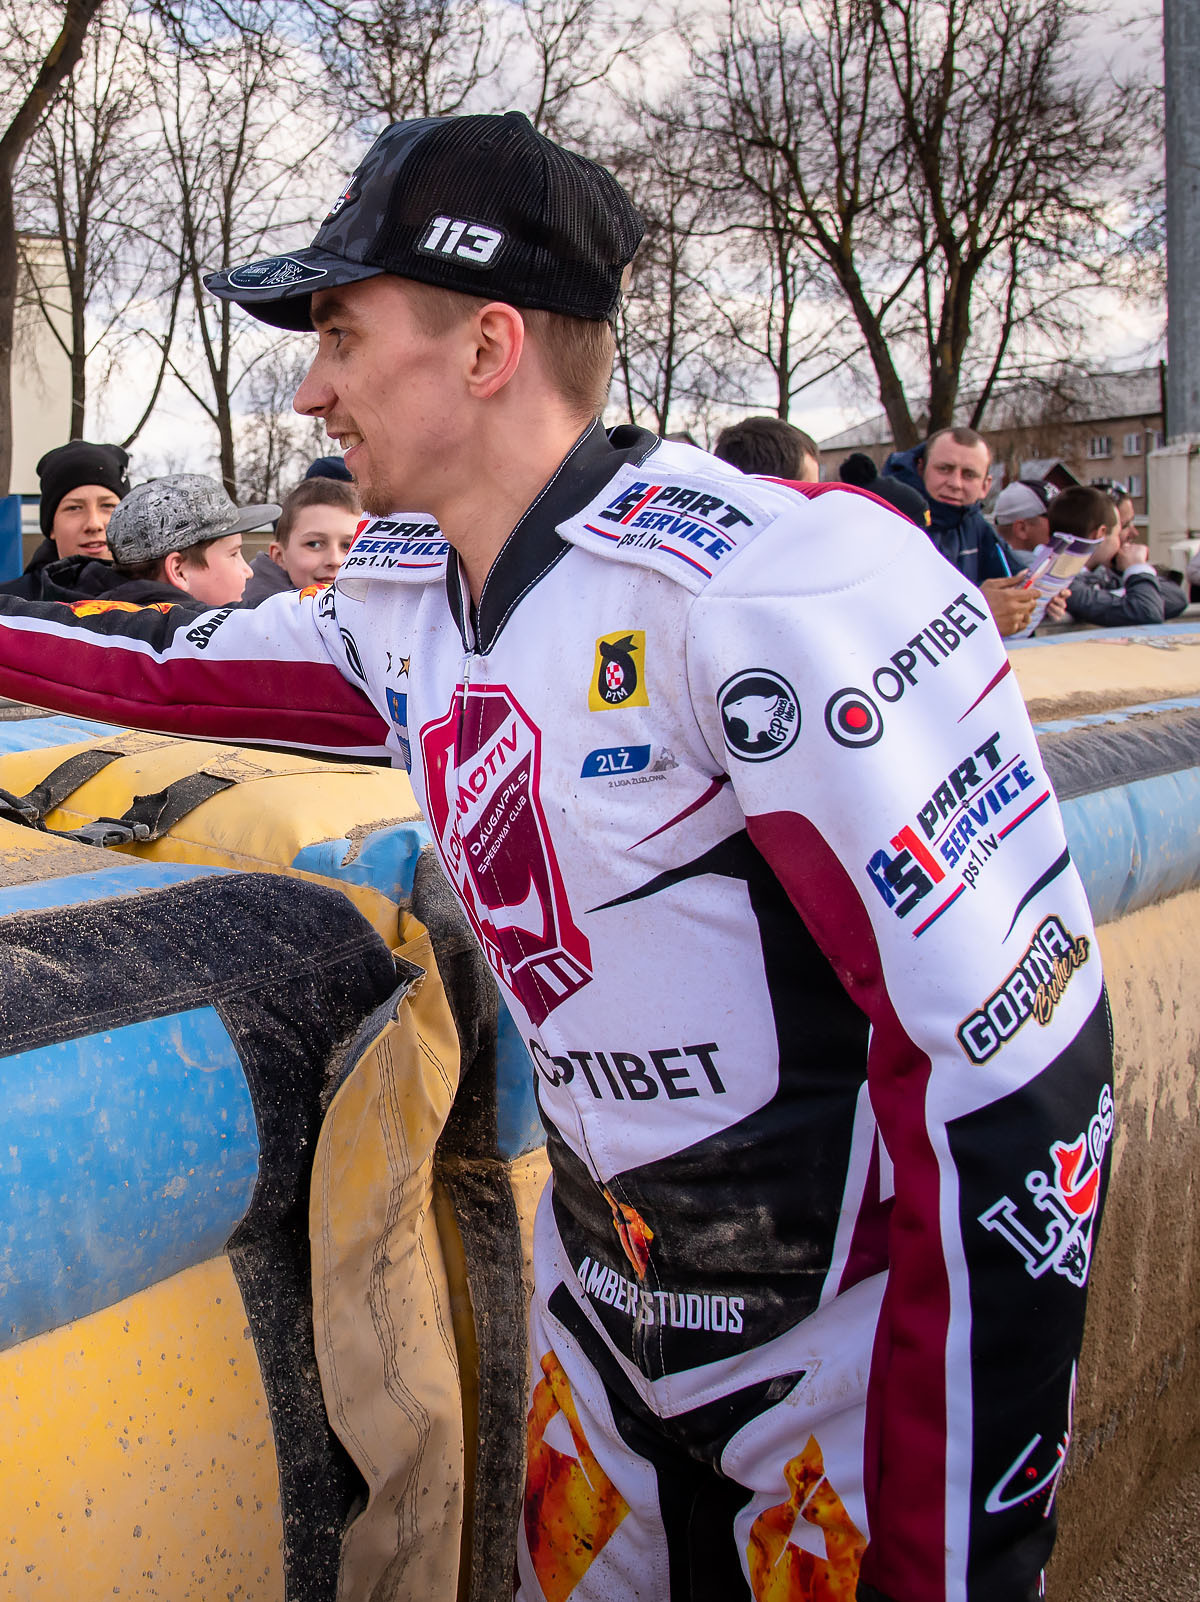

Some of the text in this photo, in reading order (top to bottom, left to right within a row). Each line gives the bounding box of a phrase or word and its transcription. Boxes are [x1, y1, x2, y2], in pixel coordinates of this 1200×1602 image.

[423, 215, 503, 263] 113
[365, 520, 444, 538] PAR
[649, 486, 754, 528] PART
[352, 540, 449, 556] SERVICE
[617, 531, 663, 549] ps1.lv
[630, 512, 733, 561] SERVICE
[345, 555, 398, 569] ps1.lv
[872, 592, 988, 703] OPTIBET
[605, 687, 628, 702] PZM
[768, 717, 789, 742] GP
[596, 748, 634, 773] 2LŻ
[447, 720, 517, 875] LOKMOTIV
[916, 731, 1002, 841] PART
[469, 770, 529, 857] DAUGAVPILS
[477, 795, 527, 875] SPEEDWAY CLUB
[939, 760, 1035, 869] SERVICE
[961, 833, 999, 890] ps1.lv
[959, 917, 1073, 1062] GORINA
[529, 1039, 727, 1101] OPTIBET
[577, 1256, 638, 1318] AMBER
[640, 1290, 745, 1334] STUDIOS
